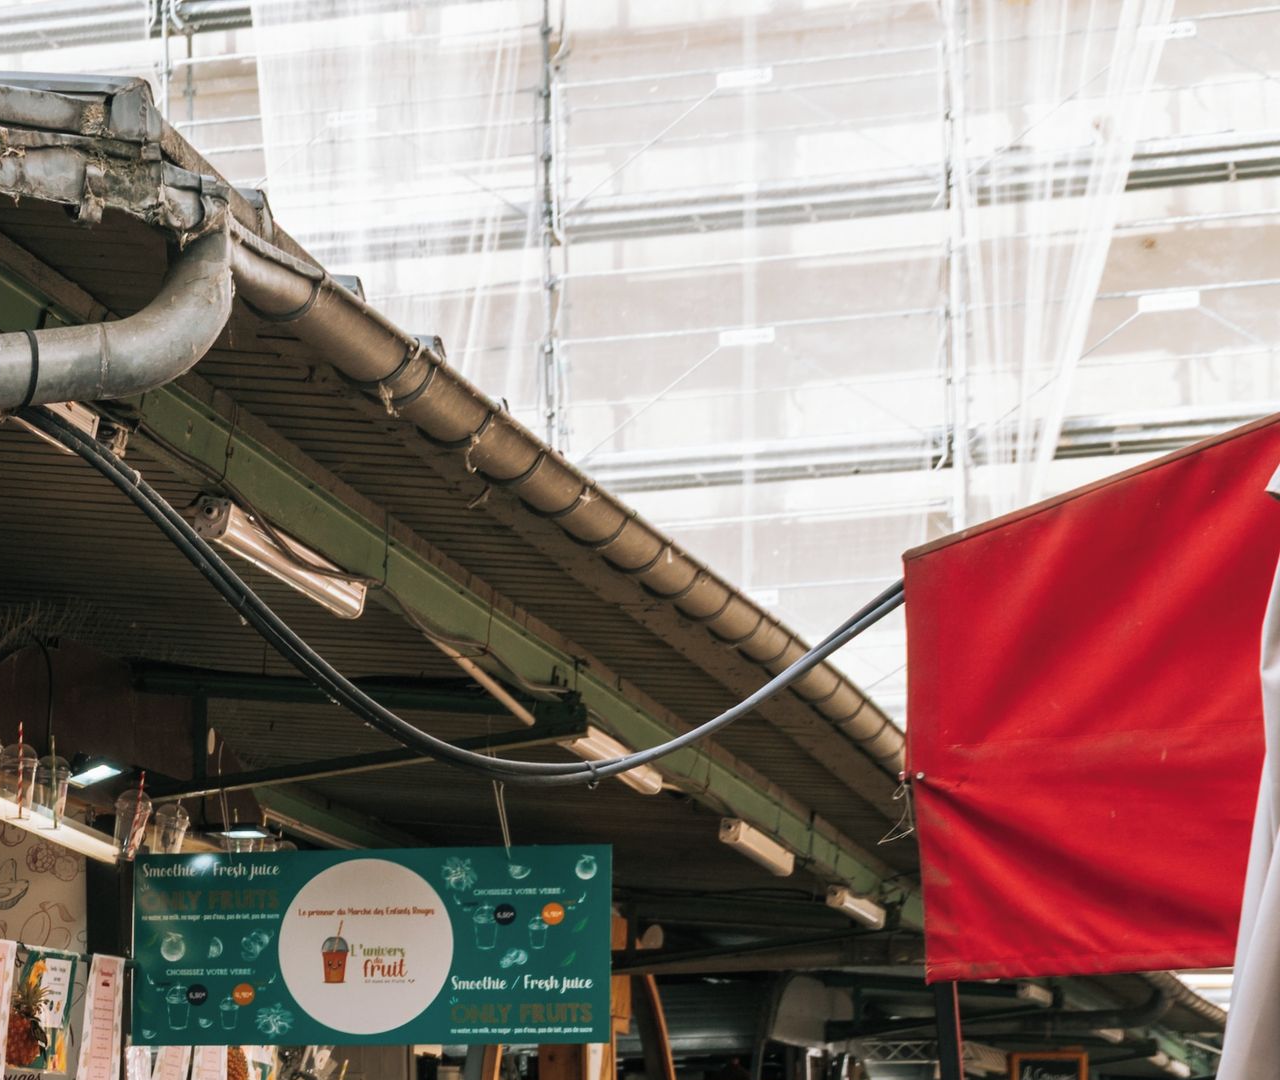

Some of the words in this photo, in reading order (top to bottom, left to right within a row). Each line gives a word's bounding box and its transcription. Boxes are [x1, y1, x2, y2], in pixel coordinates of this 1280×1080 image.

[142, 862, 196, 878] Smoothie
[212, 861, 247, 878] Fresh
[248, 863, 280, 881] juice
[363, 959, 408, 978] fruit
[451, 975, 508, 990] Smoothie
[523, 974, 560, 992] Fresh
[560, 976, 594, 994] juice
[520, 1002, 593, 1024] FRUITS
